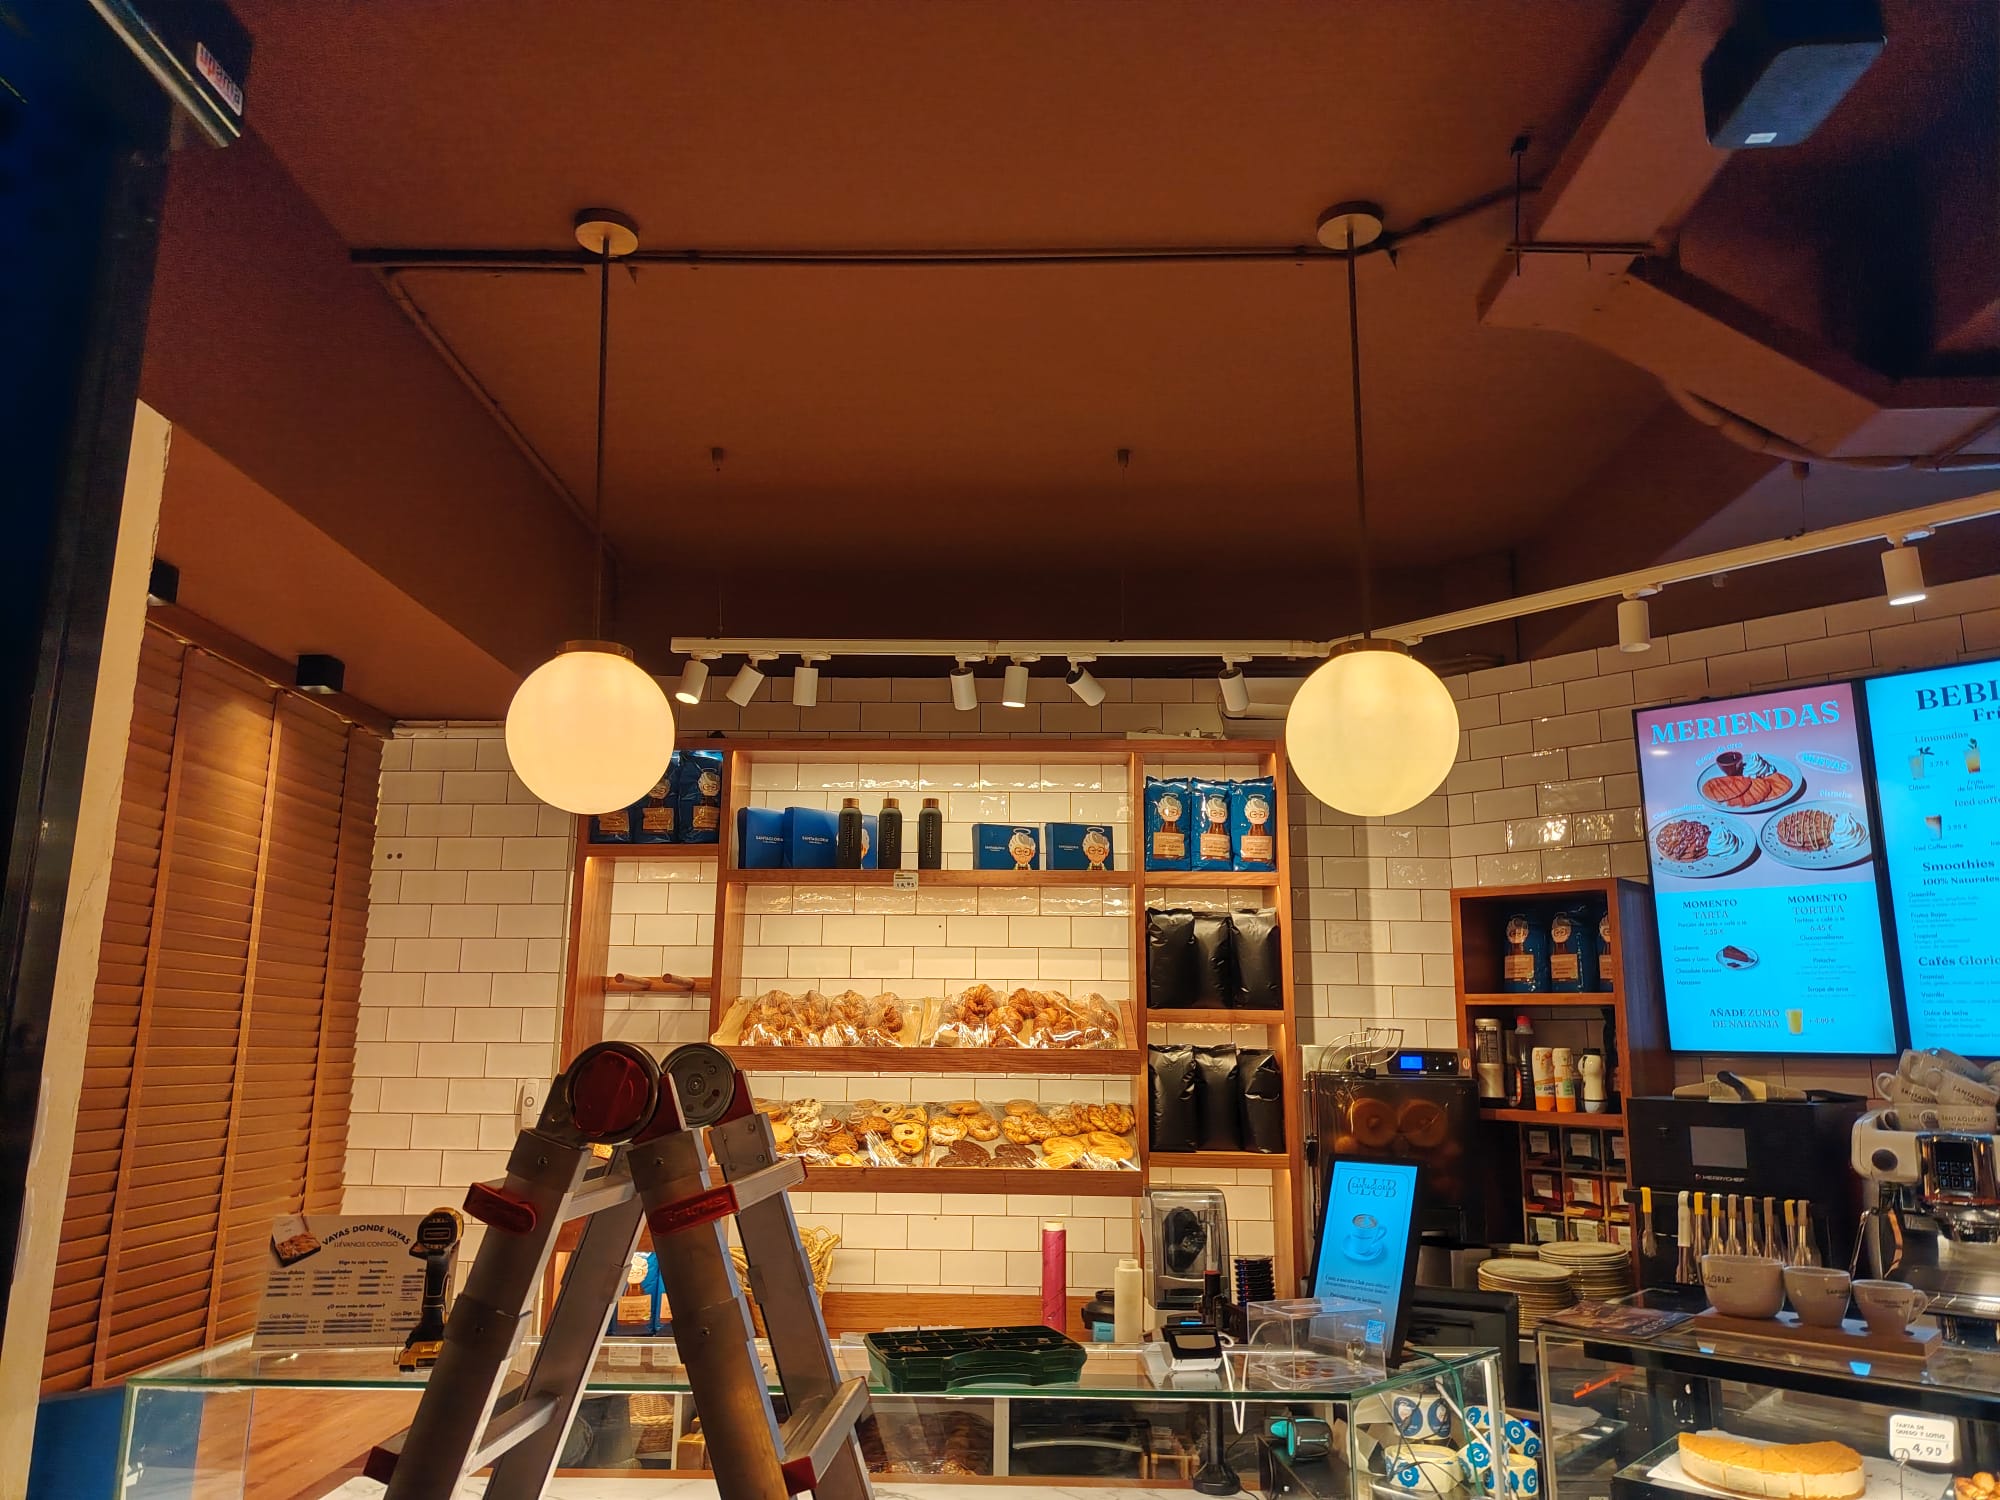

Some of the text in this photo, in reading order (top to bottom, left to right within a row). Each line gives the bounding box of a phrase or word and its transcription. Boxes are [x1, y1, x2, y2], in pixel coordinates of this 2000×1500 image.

[1651, 700, 1840, 745] MERIENDAS
[1915, 731, 1969, 743] Limonadas
[1922, 859, 1995, 871] Smoothies
[1923, 875, 2000, 886] 100% Naturales
[1683, 899, 1738, 909] MOMENTO
[1788, 893, 1848, 904] MOMENTO
[1918, 955, 1956, 967] Cafés
[1710, 1007, 1780, 1017] AÑADE ZUMO
[1712, 1020, 1780, 1028] DE NARANJA
[321, 1224, 412, 1246] VAYAS DONDE VAYAS
[367, 1239, 399, 1248] CONTIGO
